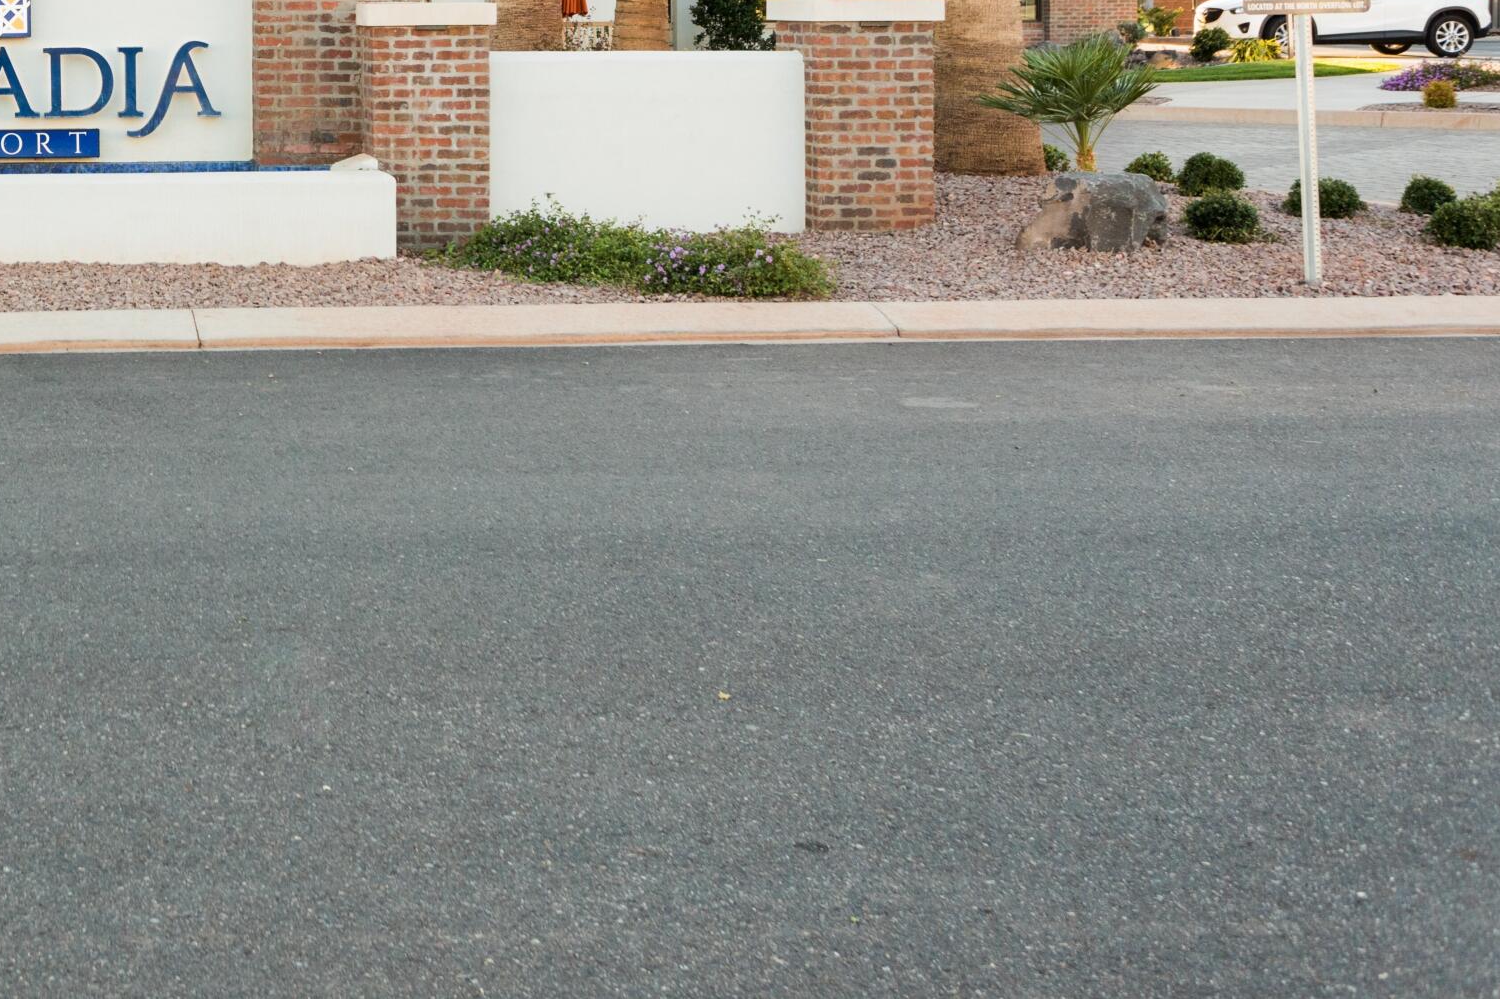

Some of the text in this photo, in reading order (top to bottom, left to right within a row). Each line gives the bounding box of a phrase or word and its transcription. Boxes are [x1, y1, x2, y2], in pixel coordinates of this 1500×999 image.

[1247, 3, 1274, 11] LOCATED
[1274, 3, 1283, 11] AT
[1283, 2, 1295, 10] THE
